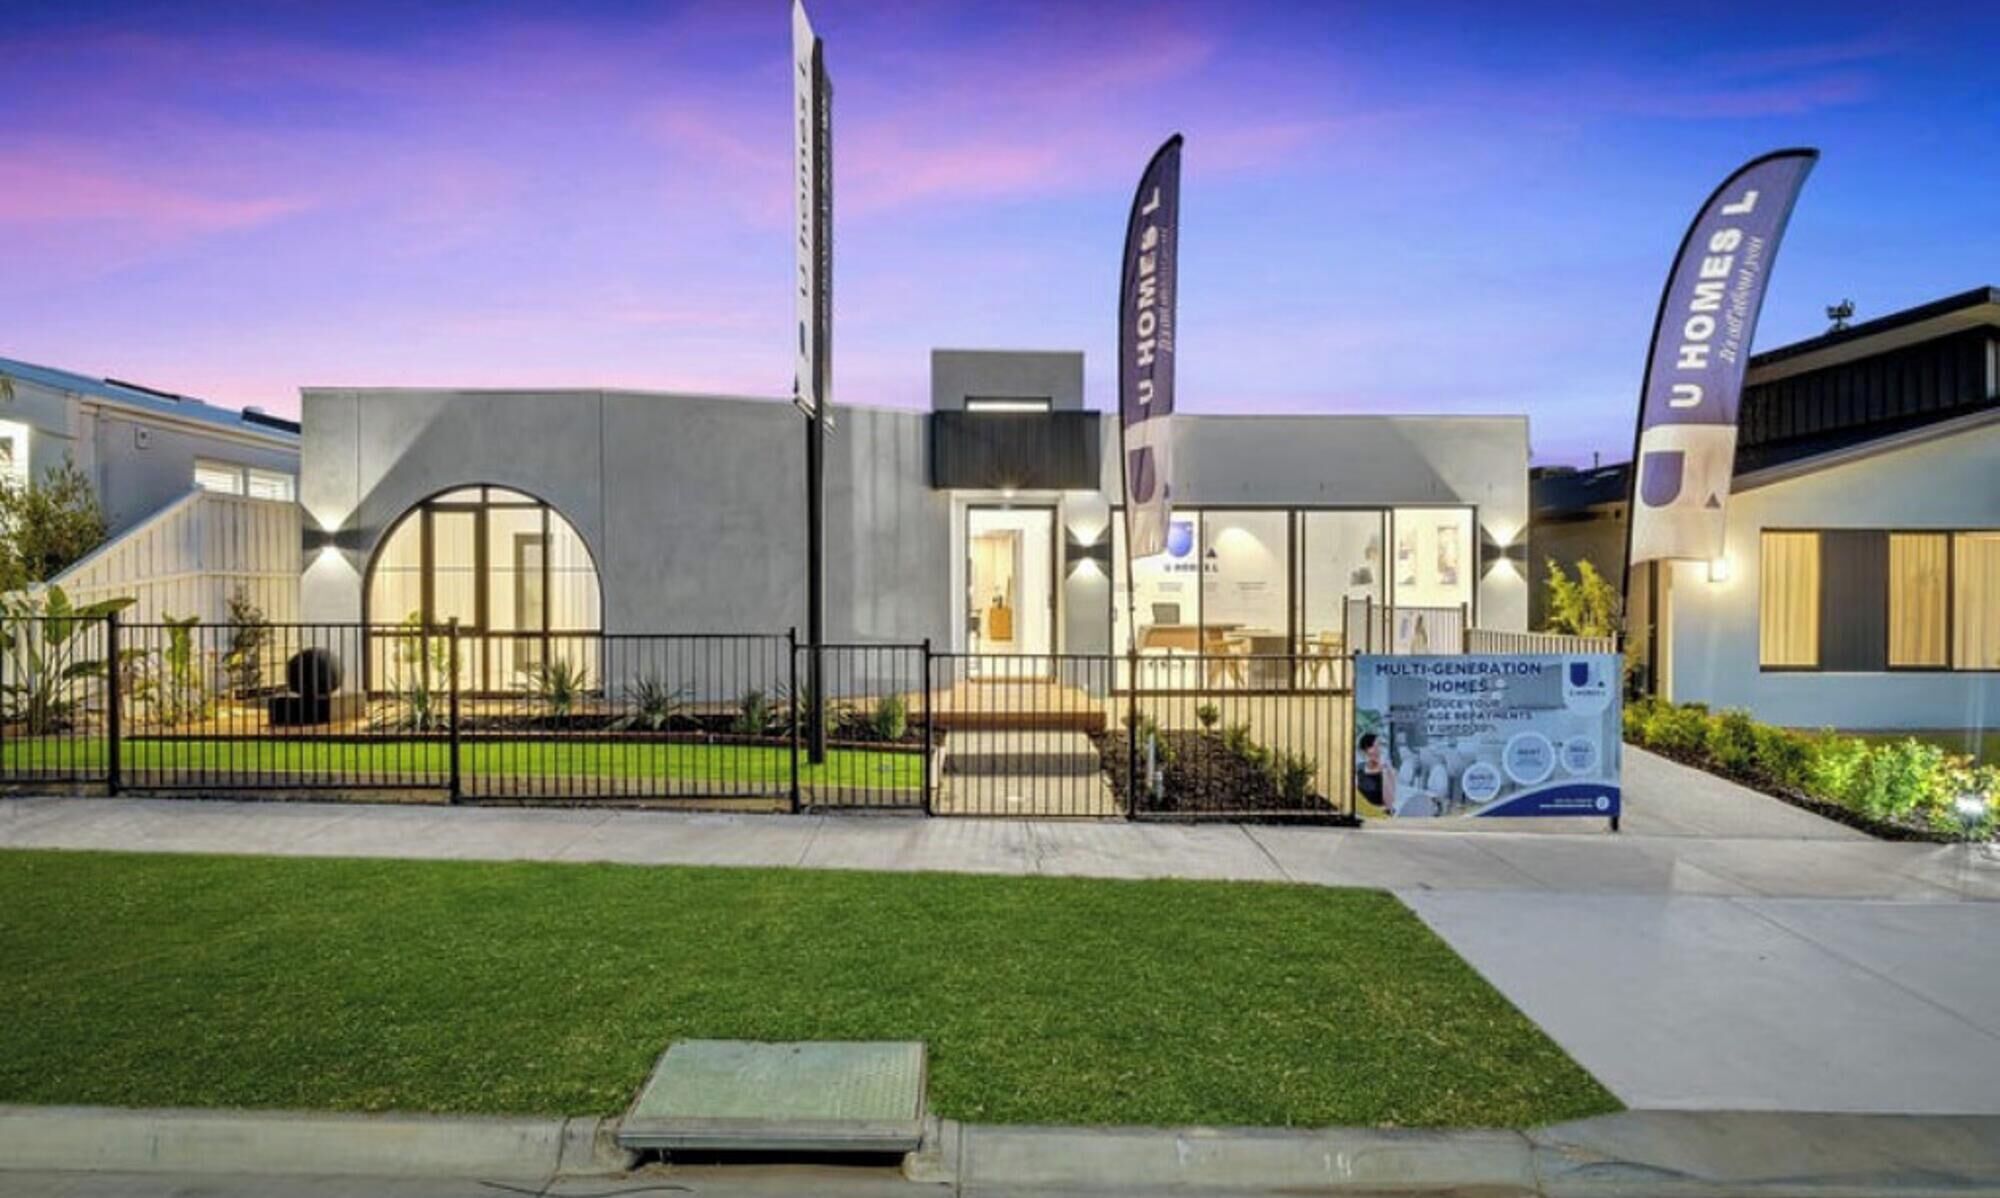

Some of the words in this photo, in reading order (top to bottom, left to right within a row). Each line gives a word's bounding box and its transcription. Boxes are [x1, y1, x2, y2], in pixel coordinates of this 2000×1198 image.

[1142, 187, 1161, 216] L
[1721, 190, 1759, 216] L
[1136, 226, 1158, 367] HOMES
[1677, 227, 1743, 370] HOMES
[1138, 379, 1154, 405] U
[1669, 384, 1703, 408] U
[1376, 662, 1542, 676] MULTI-GENERATION
[1428, 679, 1489, 693] HOMES
